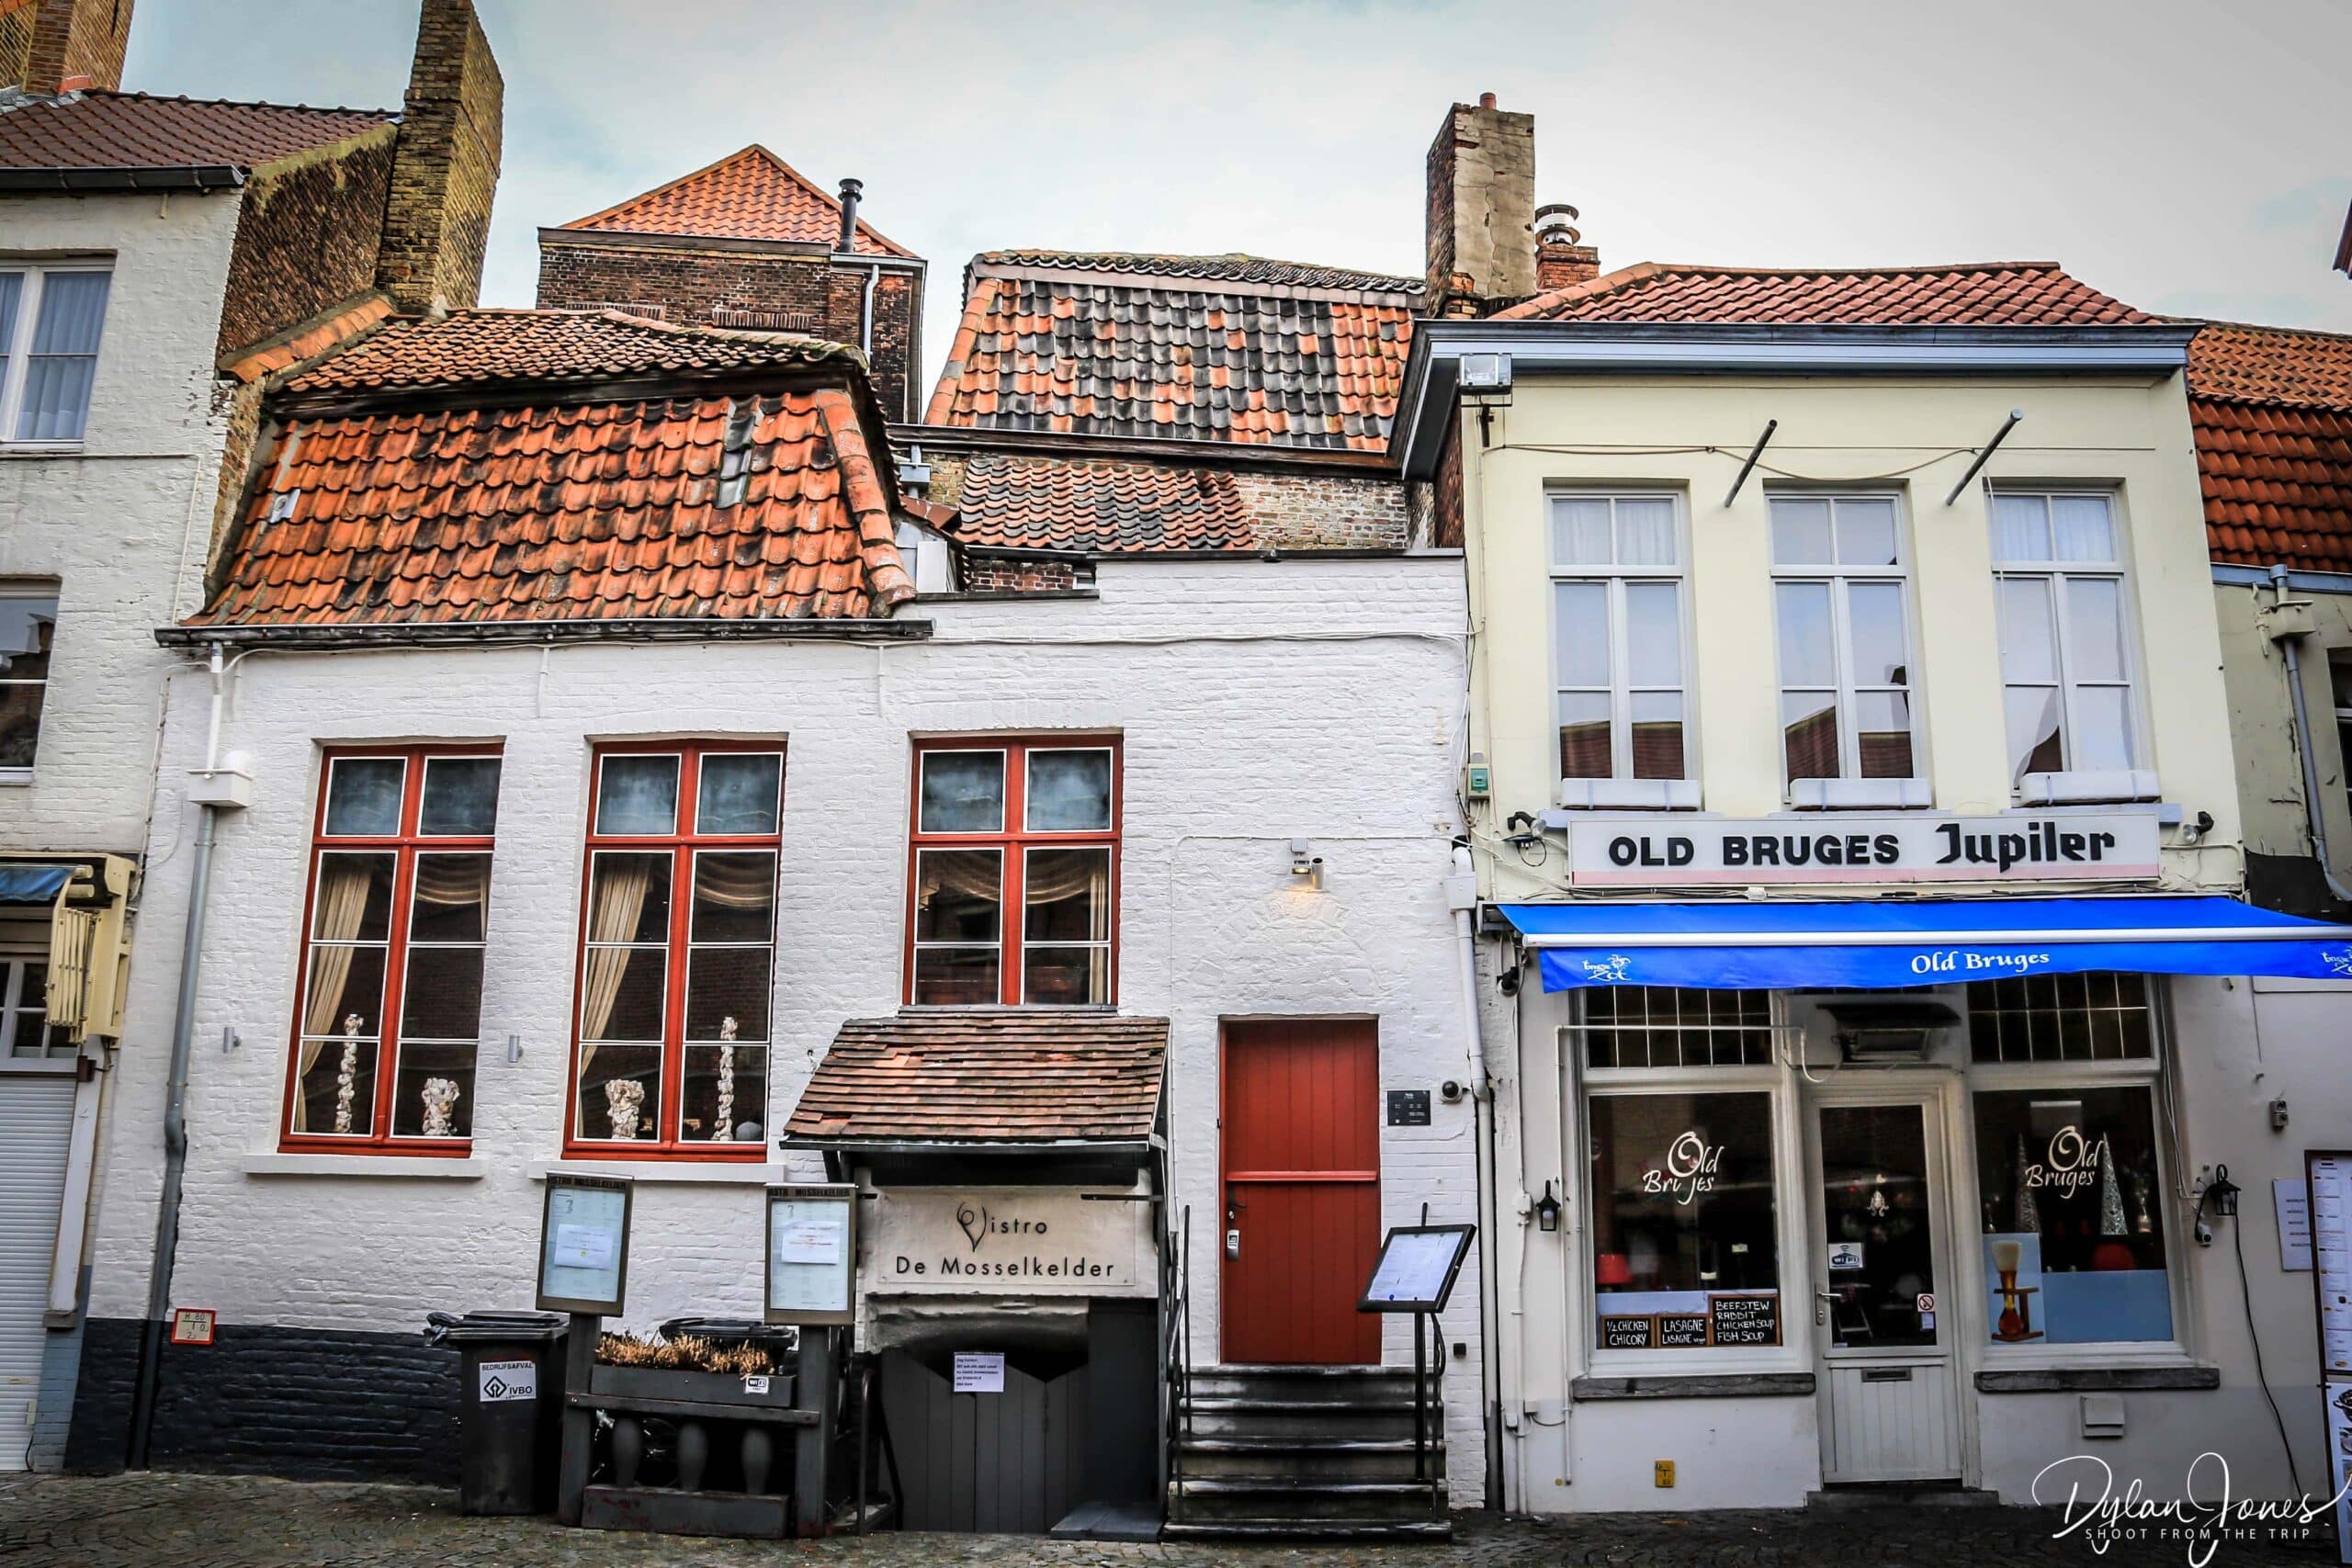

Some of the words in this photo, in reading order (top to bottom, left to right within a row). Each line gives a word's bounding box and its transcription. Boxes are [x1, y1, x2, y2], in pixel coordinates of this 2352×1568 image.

[1609, 836, 1694, 866] OLD
[1723, 834, 1900, 866] BRUGES
[1935, 821, 2116, 874] Jupiler
[1911, 951, 1959, 974] Old
[1963, 953, 2050, 973] Bruges
[1668, 1131, 1724, 1178] Old
[2048, 1125, 2104, 1172] Old
[2025, 1164, 2096, 1199] Bruges
[896, 1256, 926, 1275] De
[941, 1256, 1114, 1277] Mosselkelder
[1715, 1301, 1770, 1311] BEEFSTEW
[1716, 1312, 1757, 1320] RABBIT
[1664, 1319, 1704, 1333] LASAGNE
[1610, 1334, 1646, 1346] CHICORY
[1662, 1334, 1691, 1344] LASAGNE
[1717, 1332, 1739, 1341] FISH
[509, 1385, 533, 1394] IVBO
